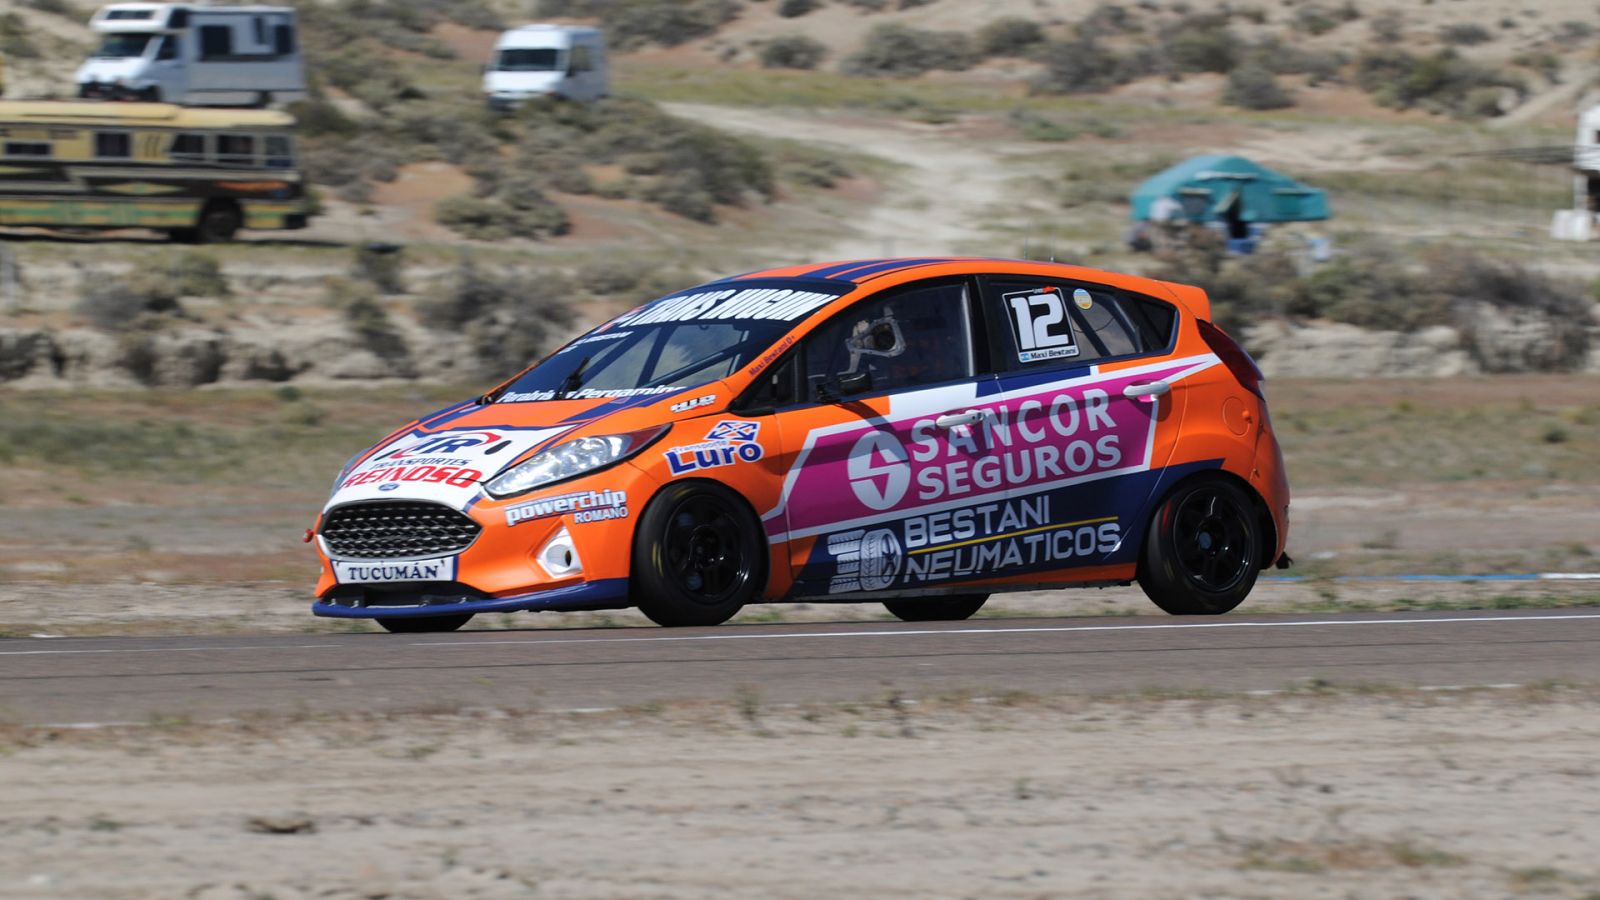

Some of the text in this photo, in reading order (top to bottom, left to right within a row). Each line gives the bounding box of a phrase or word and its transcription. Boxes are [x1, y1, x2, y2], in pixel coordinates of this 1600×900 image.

[618, 289, 737, 328] TRANS
[1009, 293, 1070, 350] 12
[1030, 347, 1077, 360] Maxi Bestani
[910, 388, 1118, 463] SANCOR
[341, 465, 483, 489] REINOSO
[370, 457, 472, 471] TRANSPORTES
[664, 443, 763, 475] Luro
[917, 434, 1122, 500] SEGUROS
[505, 488, 627, 527] powerchip
[574, 506, 629, 524] ROMANO
[904, 495, 1050, 549] BESTANI
[347, 562, 439, 580] TUCUMÁN
[903, 522, 1122, 583] NEUMATICOS
